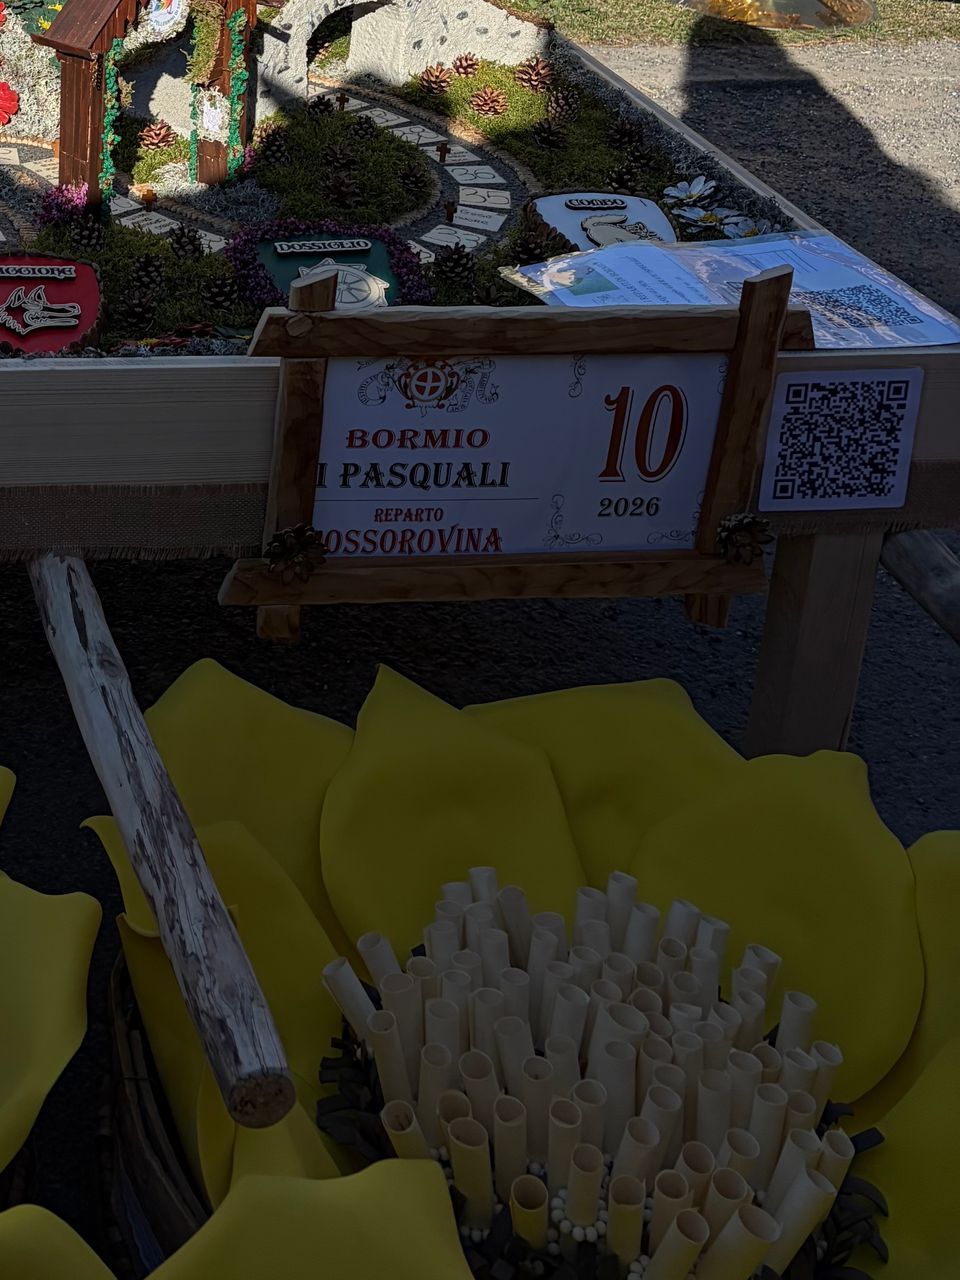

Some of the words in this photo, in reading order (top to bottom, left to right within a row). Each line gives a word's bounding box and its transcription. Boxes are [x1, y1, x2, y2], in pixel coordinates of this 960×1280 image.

[461, 188, 510, 205] 35
[568, 199, 626, 208] COMBO
[277, 240, 370, 252] DOSSIGLIO
[345, 428, 491, 451] BORMIO
[597, 383, 689, 483] 10
[339, 461, 512, 492] PASQUALI
[373, 507, 445, 523] REPARTO
[597, 496, 661, 518] 2026
